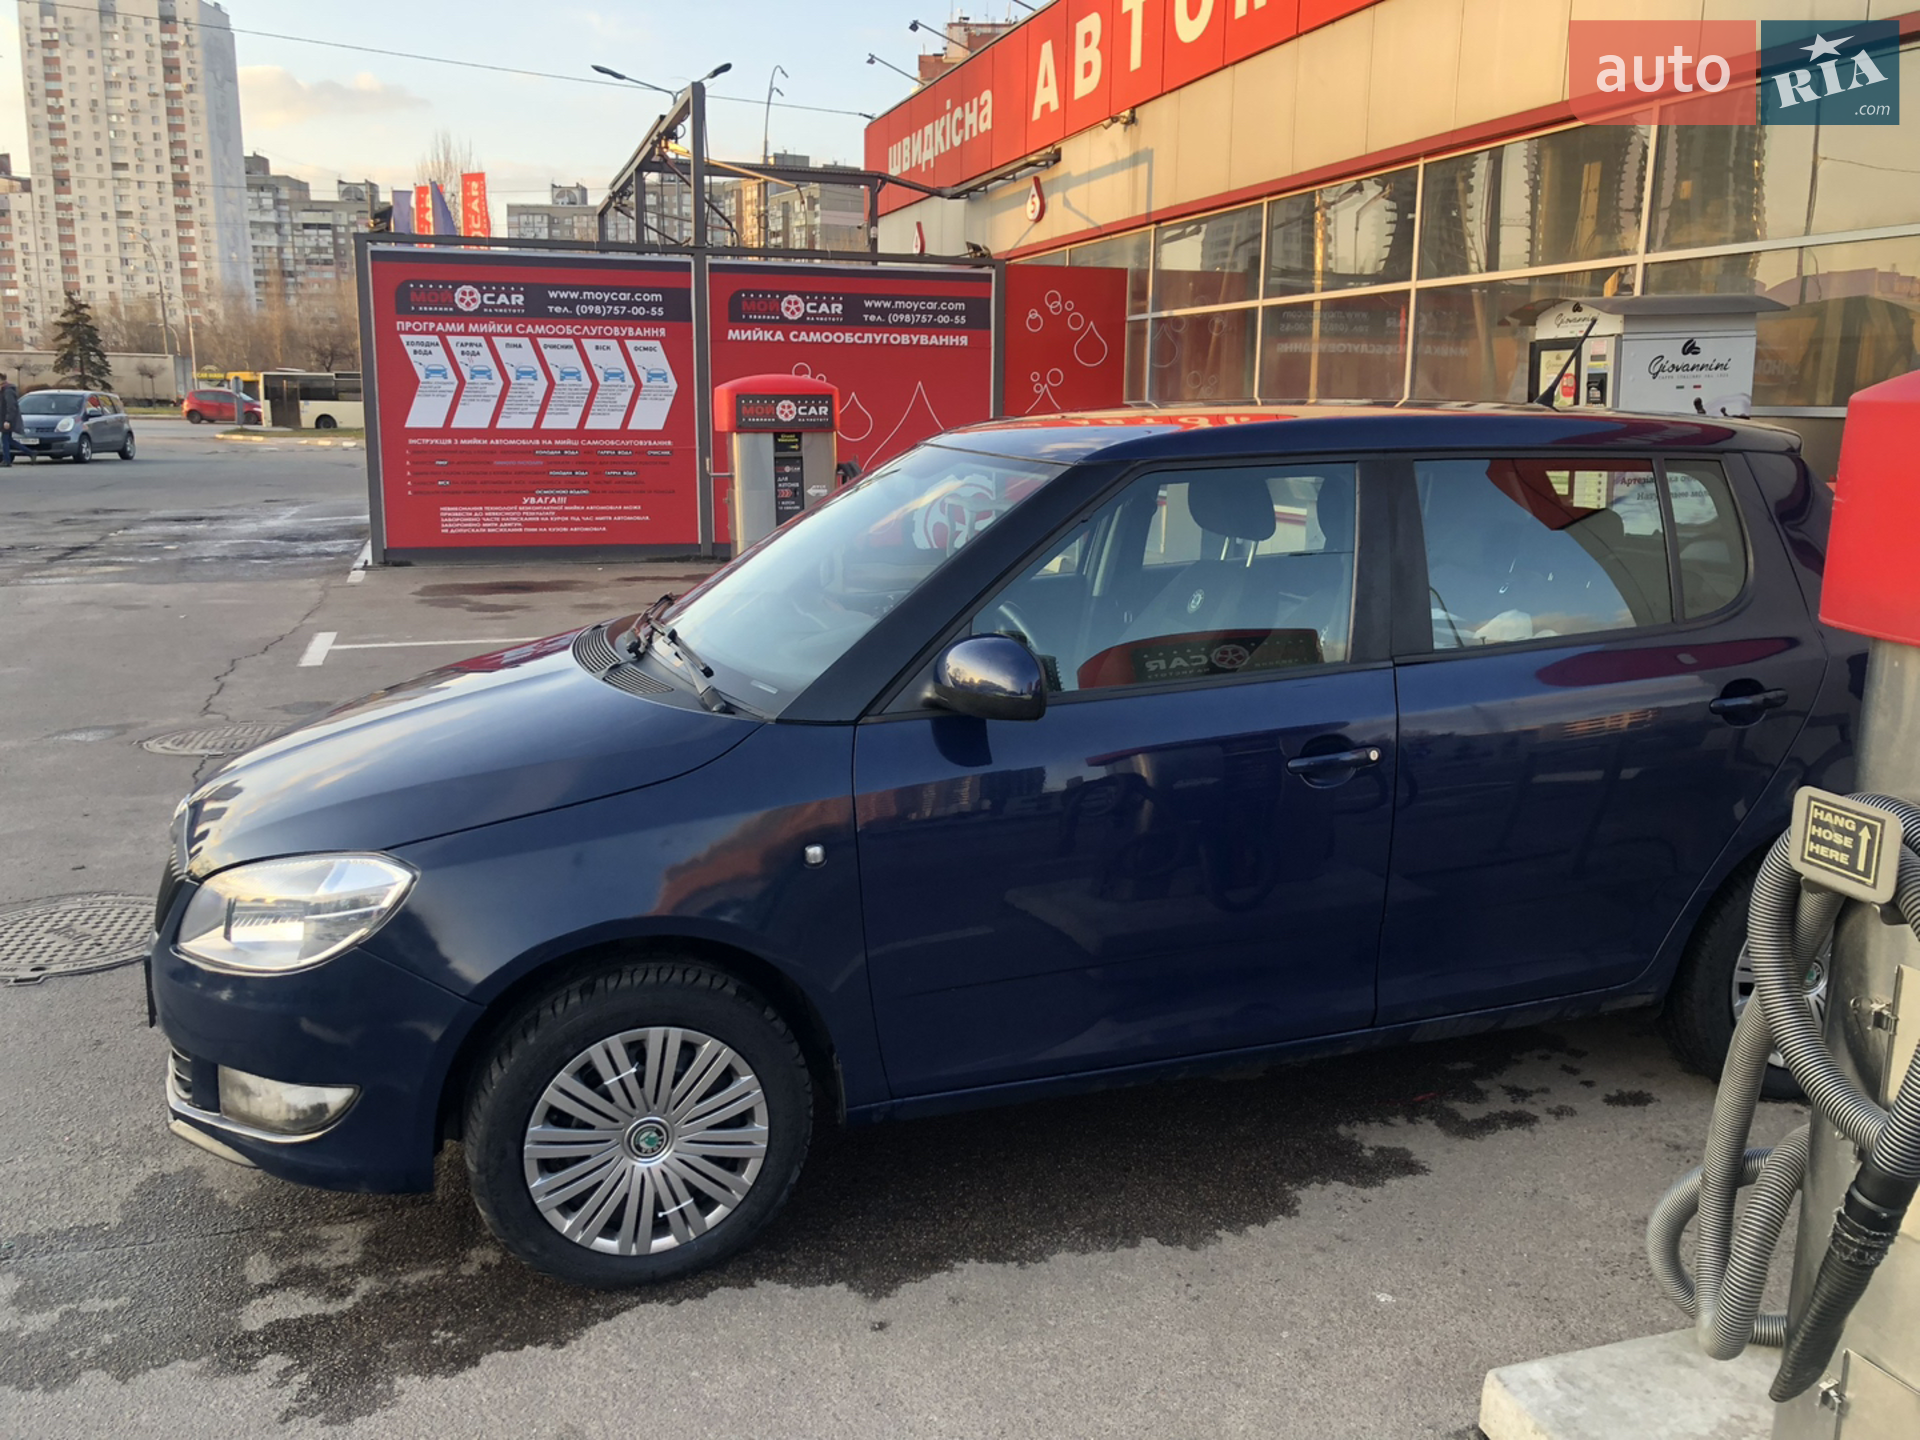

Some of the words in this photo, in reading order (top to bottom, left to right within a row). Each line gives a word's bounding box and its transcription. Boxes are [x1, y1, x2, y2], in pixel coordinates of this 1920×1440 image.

[888, 89, 992, 177] швидкісна
[1031, 0, 1268, 122] АВТО
[410, 289, 454, 303] МОЙ
[483, 293, 525, 305] CAR
[547, 290, 663, 303] www.moycar.com
[547, 305, 573, 314] тел.
[806, 302, 843, 314] CAR
[863, 299, 966, 311] www.moycar.com
[863, 314, 885, 322] тел.
[396, 321, 465, 332] ПРОГРАМИ
[468, 321, 513, 334] МИЙКИ
[516, 323, 666, 337] САМООБСЛУГОВУВАННЯ
[728, 328, 785, 342] МИЙКА
[789, 331, 968, 347] САМООБСЛУГОВУВАННЯ
[1648, 355, 1732, 380] Giovannini
[797, 406, 829, 416] CAR
[1813, 807, 1857, 832] HANG
[1811, 825, 1854, 849] HOSE
[1809, 842, 1850, 865] HERE
